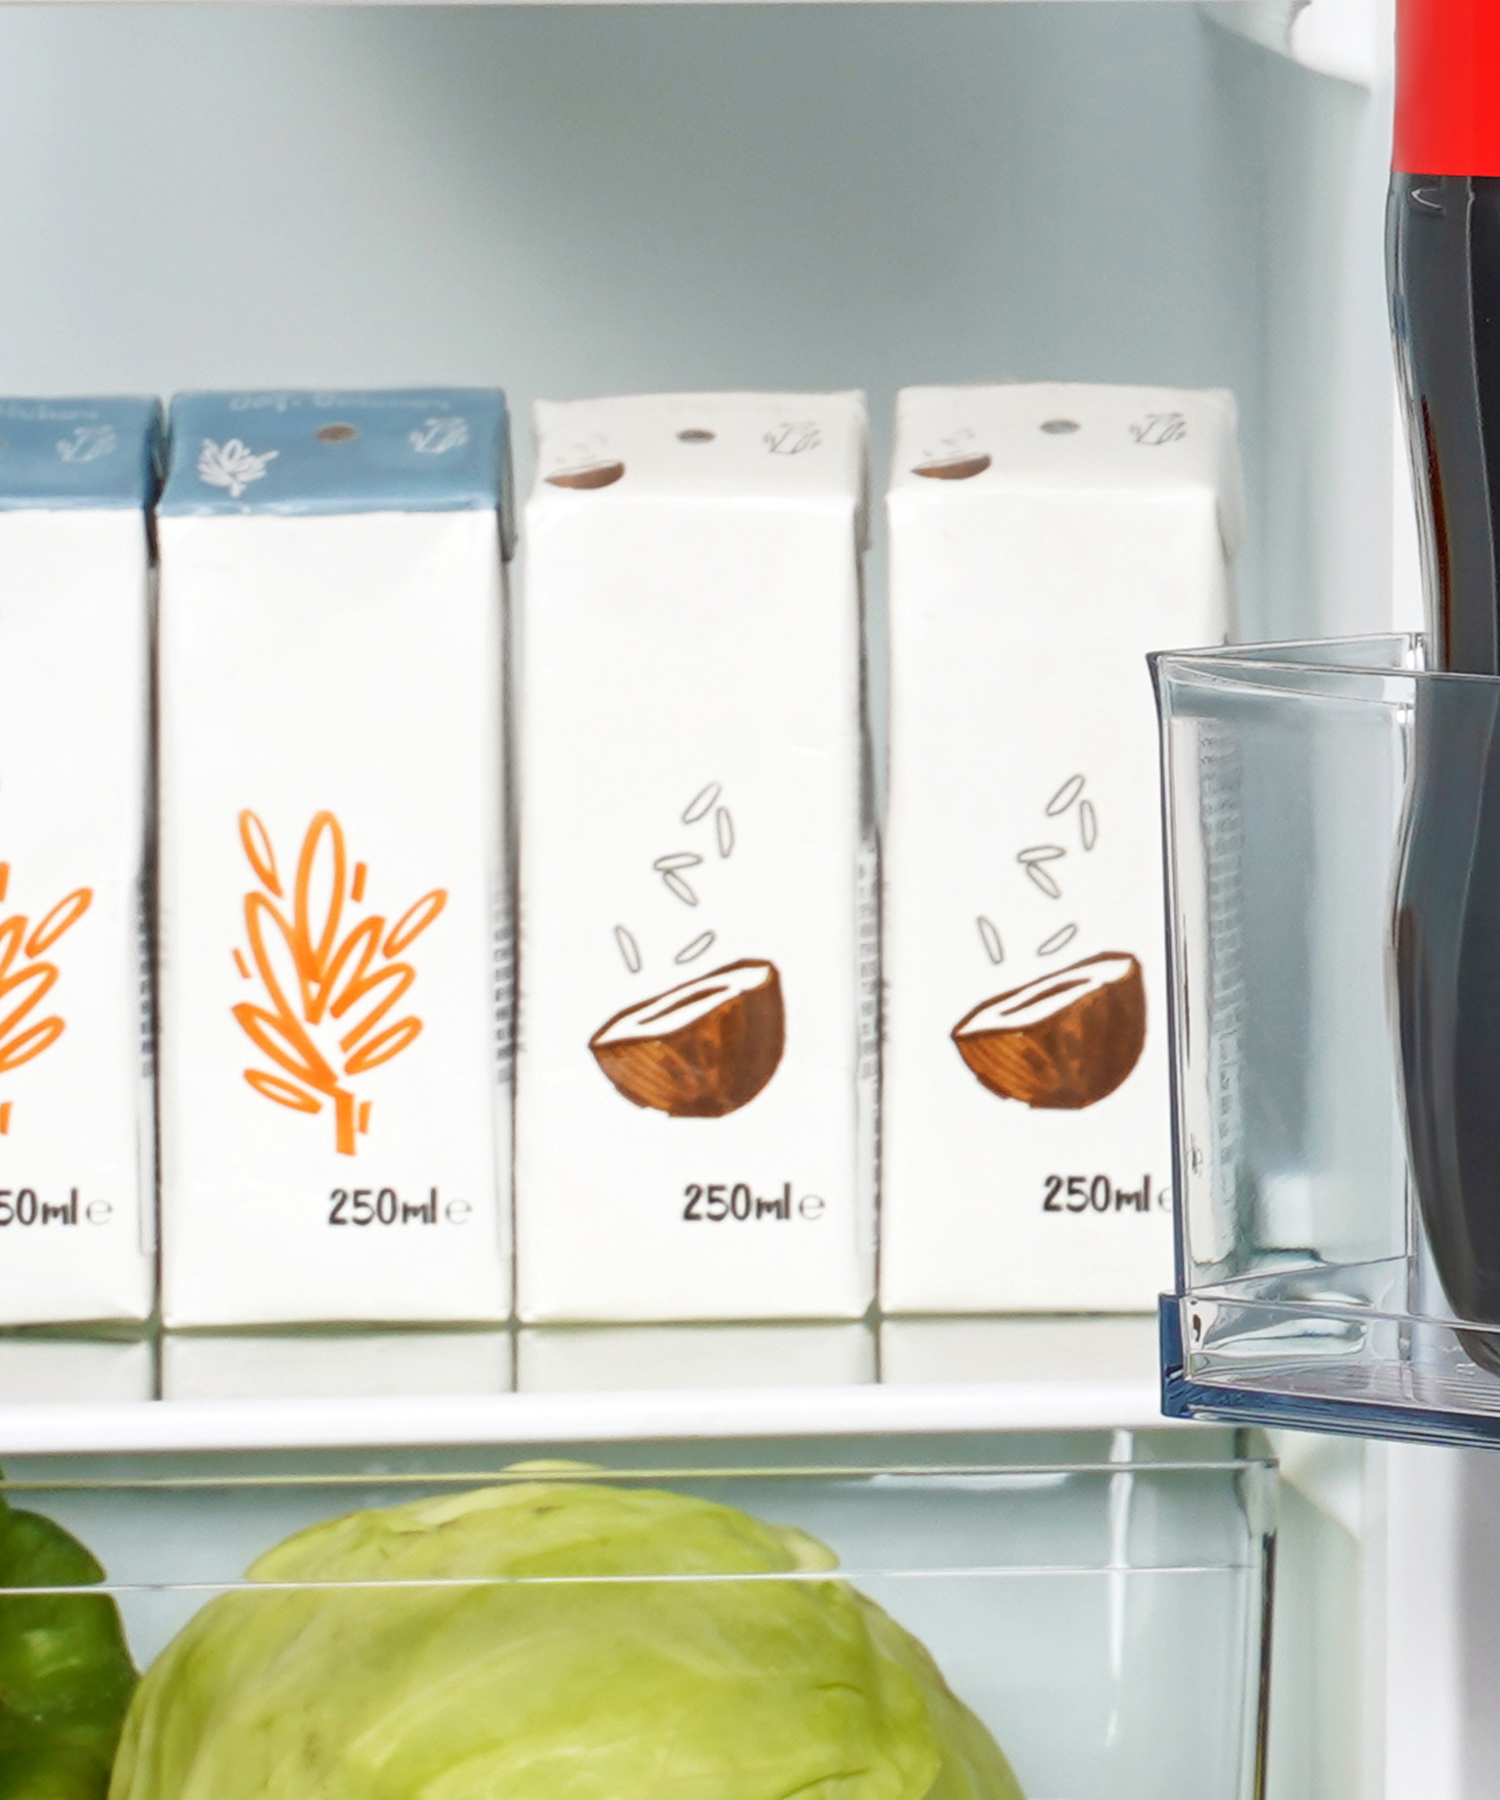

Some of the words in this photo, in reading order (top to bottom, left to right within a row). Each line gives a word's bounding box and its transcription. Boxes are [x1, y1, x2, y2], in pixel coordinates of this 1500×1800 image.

[327, 1186, 437, 1226] 250ml
[683, 1181, 792, 1221] 250ml
[1042, 1174, 1151, 1213] 250ml
